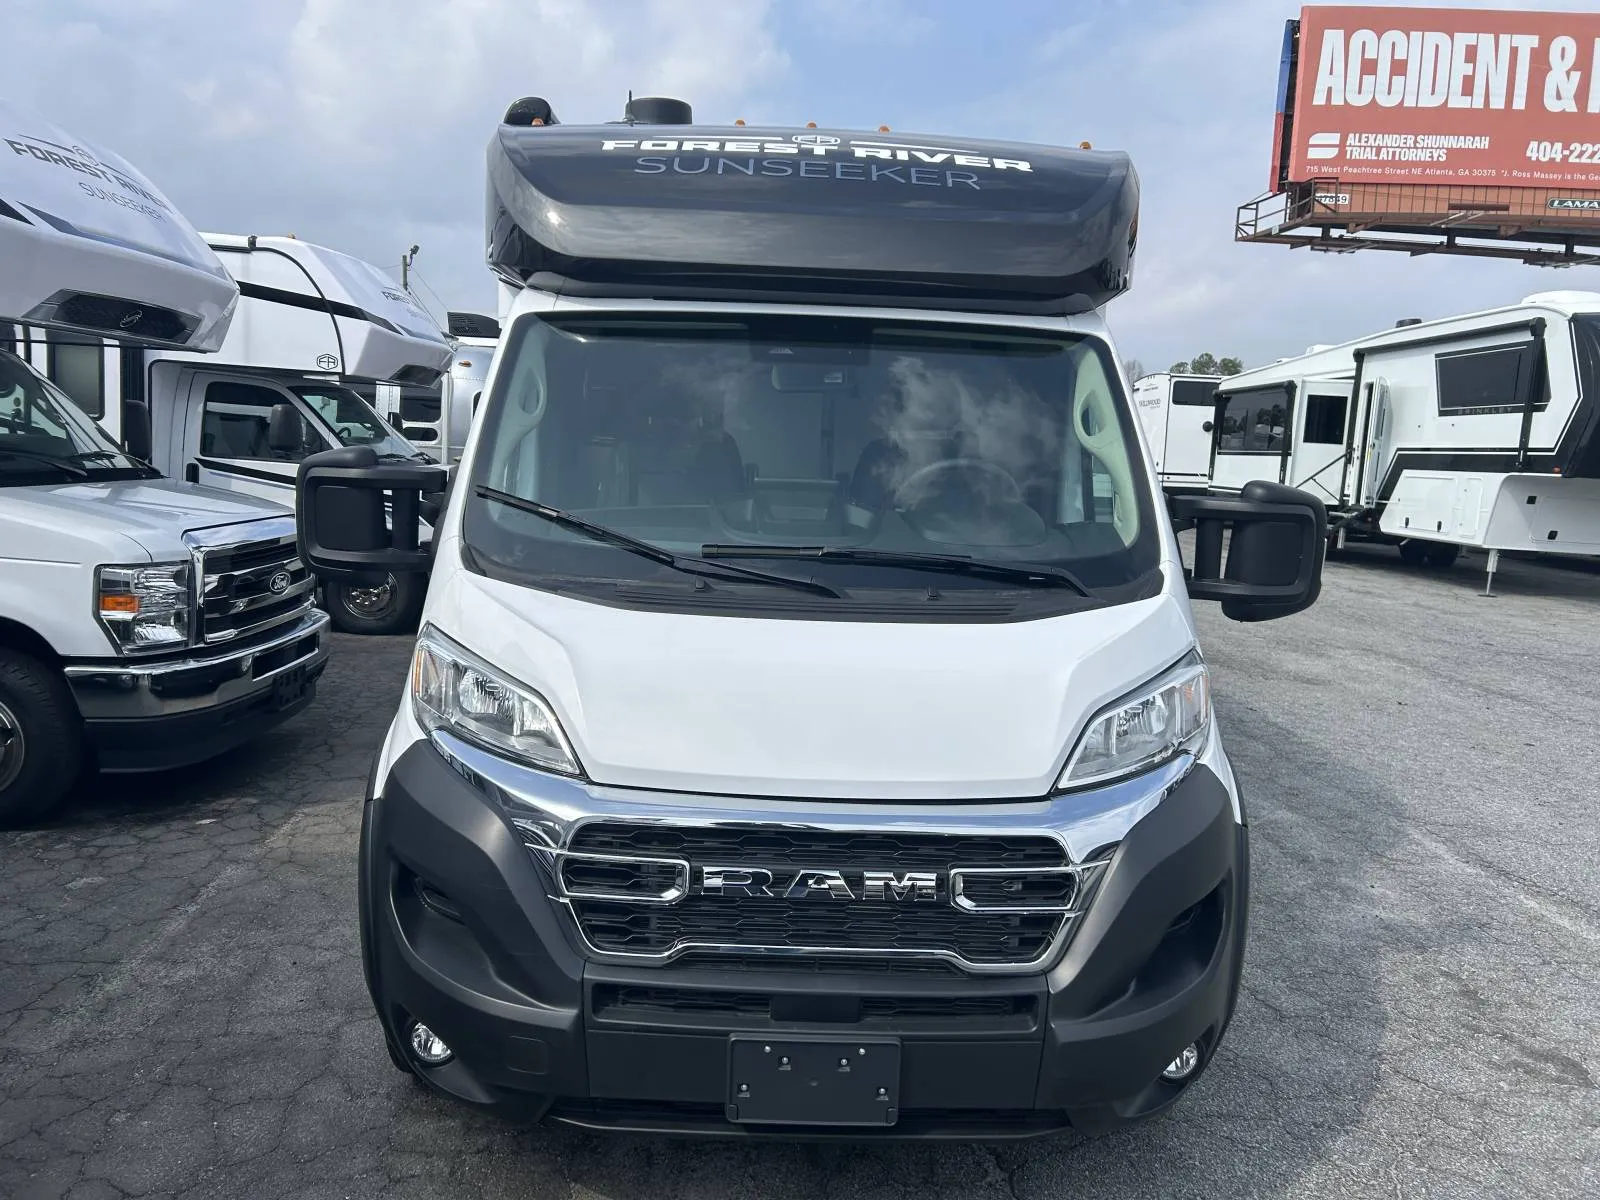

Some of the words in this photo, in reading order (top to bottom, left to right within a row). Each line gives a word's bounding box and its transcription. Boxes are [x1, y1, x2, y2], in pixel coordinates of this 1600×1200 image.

[1312, 29, 1539, 110] ACCIDENT
[1543, 35, 1581, 112] &
[601, 139, 838, 155] FOREST
[851, 147, 1034, 173] RIVER
[1345, 146, 1378, 160] TRIAL
[1379, 148, 1447, 162] ATTORNEYS
[1346, 133, 1415, 147] ALEXANDER
[1416, 134, 1489, 149] SHUNNARAH
[3, 138, 112, 183] FOREST
[633, 156, 981, 190] SUNSEEKER
[1306, 165, 1319, 173] 715
[1321, 165, 1341, 173] West
[1343, 165, 1383, 174] Peachtree
[1385, 167, 1409, 175] Street
[1411, 167, 1423, 175] NE
[1425, 168, 1456, 176] Atlanta,
[1458, 168, 1470, 176] GA
[1472, 169, 1496, 177] 30375
[1512, 169, 1531, 178] Ross
[1533, 171, 1562, 181] Massey
[1564, 172, 1571, 180] is
[1573, 172, 1586, 180] the
[1457, 407, 1513, 416] BRINKLEY
[700, 866, 937, 901] RAM
